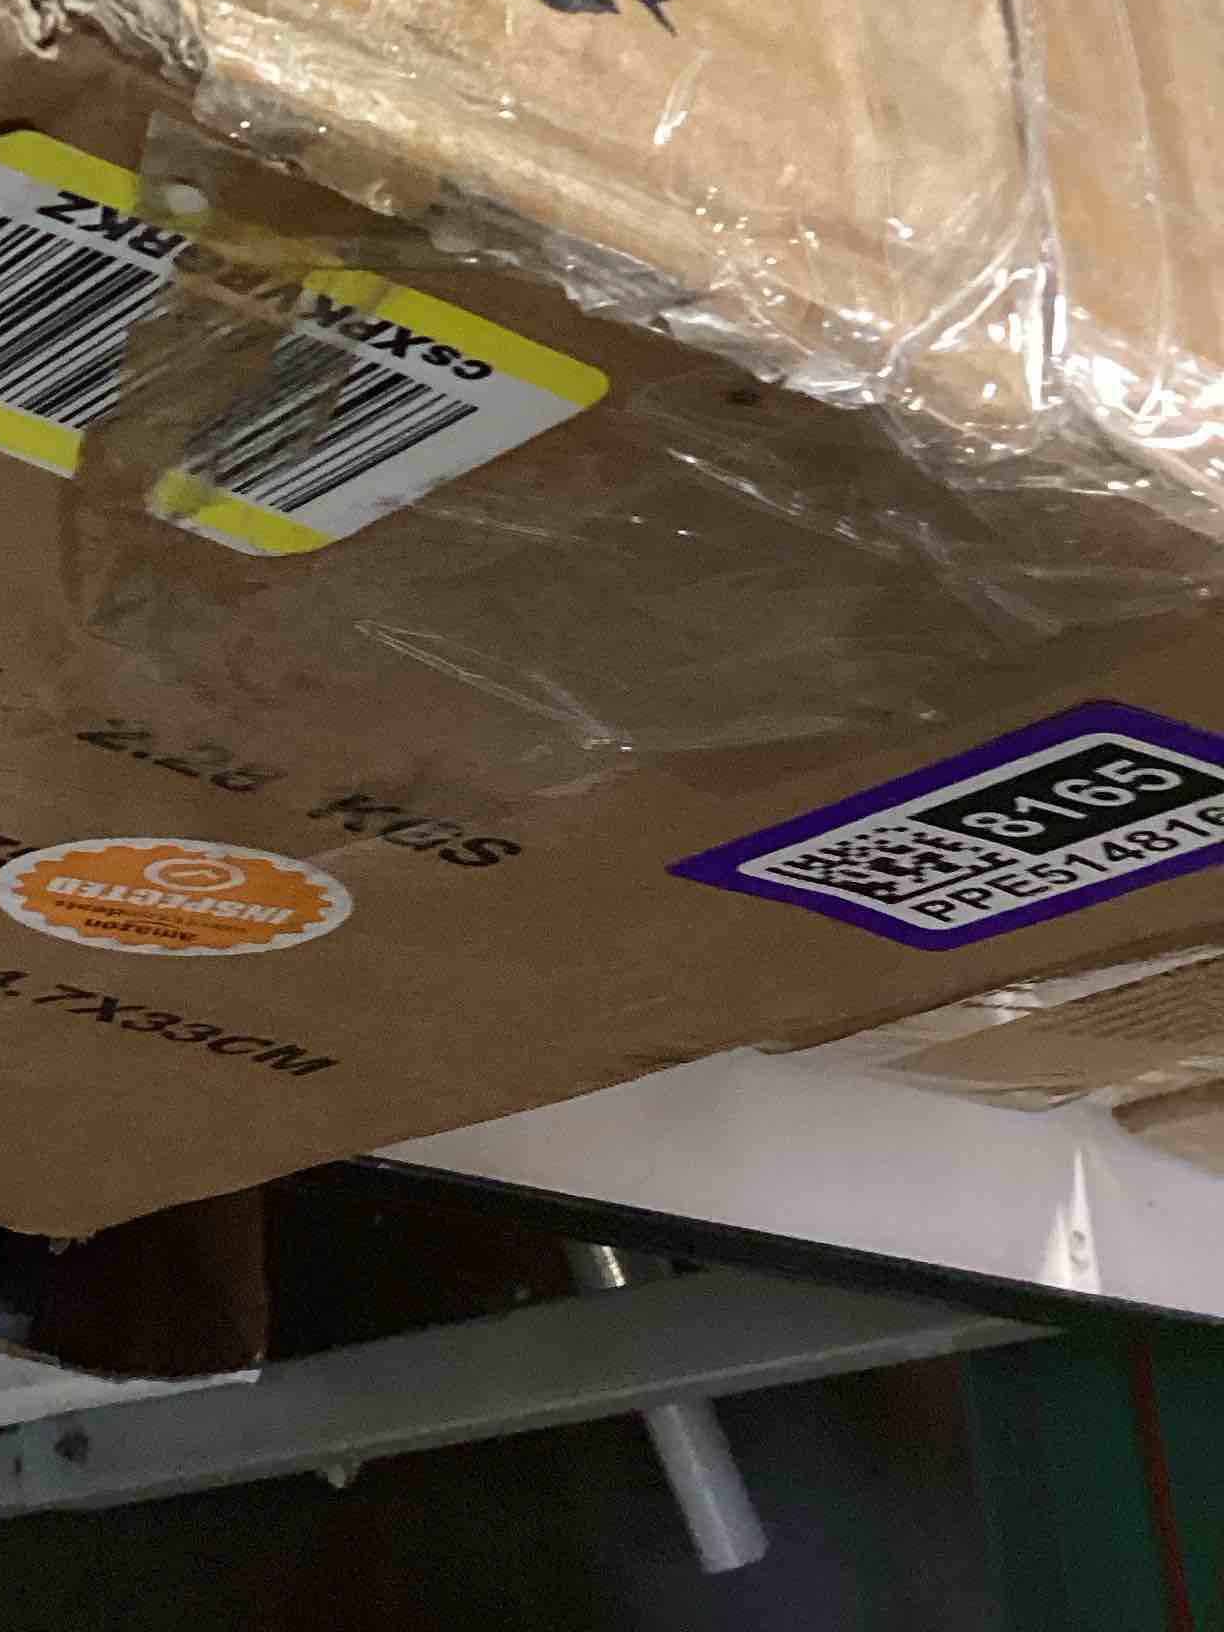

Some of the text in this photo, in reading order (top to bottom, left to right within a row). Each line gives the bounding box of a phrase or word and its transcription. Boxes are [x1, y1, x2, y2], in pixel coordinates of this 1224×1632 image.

[306, 792, 522, 867] KGS
[961, 759, 1184, 838] 8165
[46, 875, 296, 925] INSPECTED
[82, 917, 199, 943] amazon
